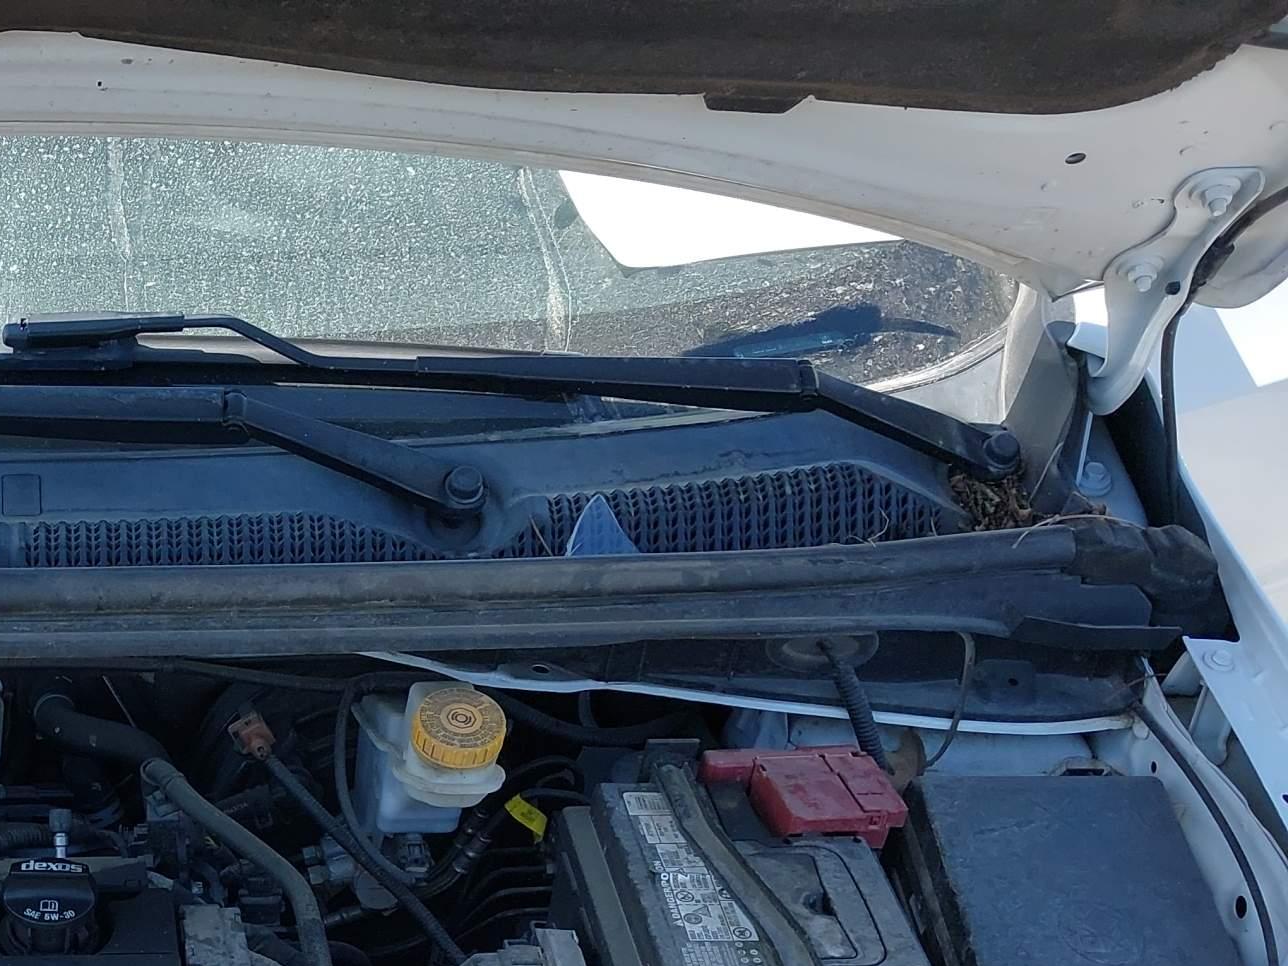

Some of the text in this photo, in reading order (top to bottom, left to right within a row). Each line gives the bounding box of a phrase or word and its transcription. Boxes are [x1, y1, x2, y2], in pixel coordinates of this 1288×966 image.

[20, 859, 83, 873] dexos
[23, 908, 76, 921] SAE 5W-30
